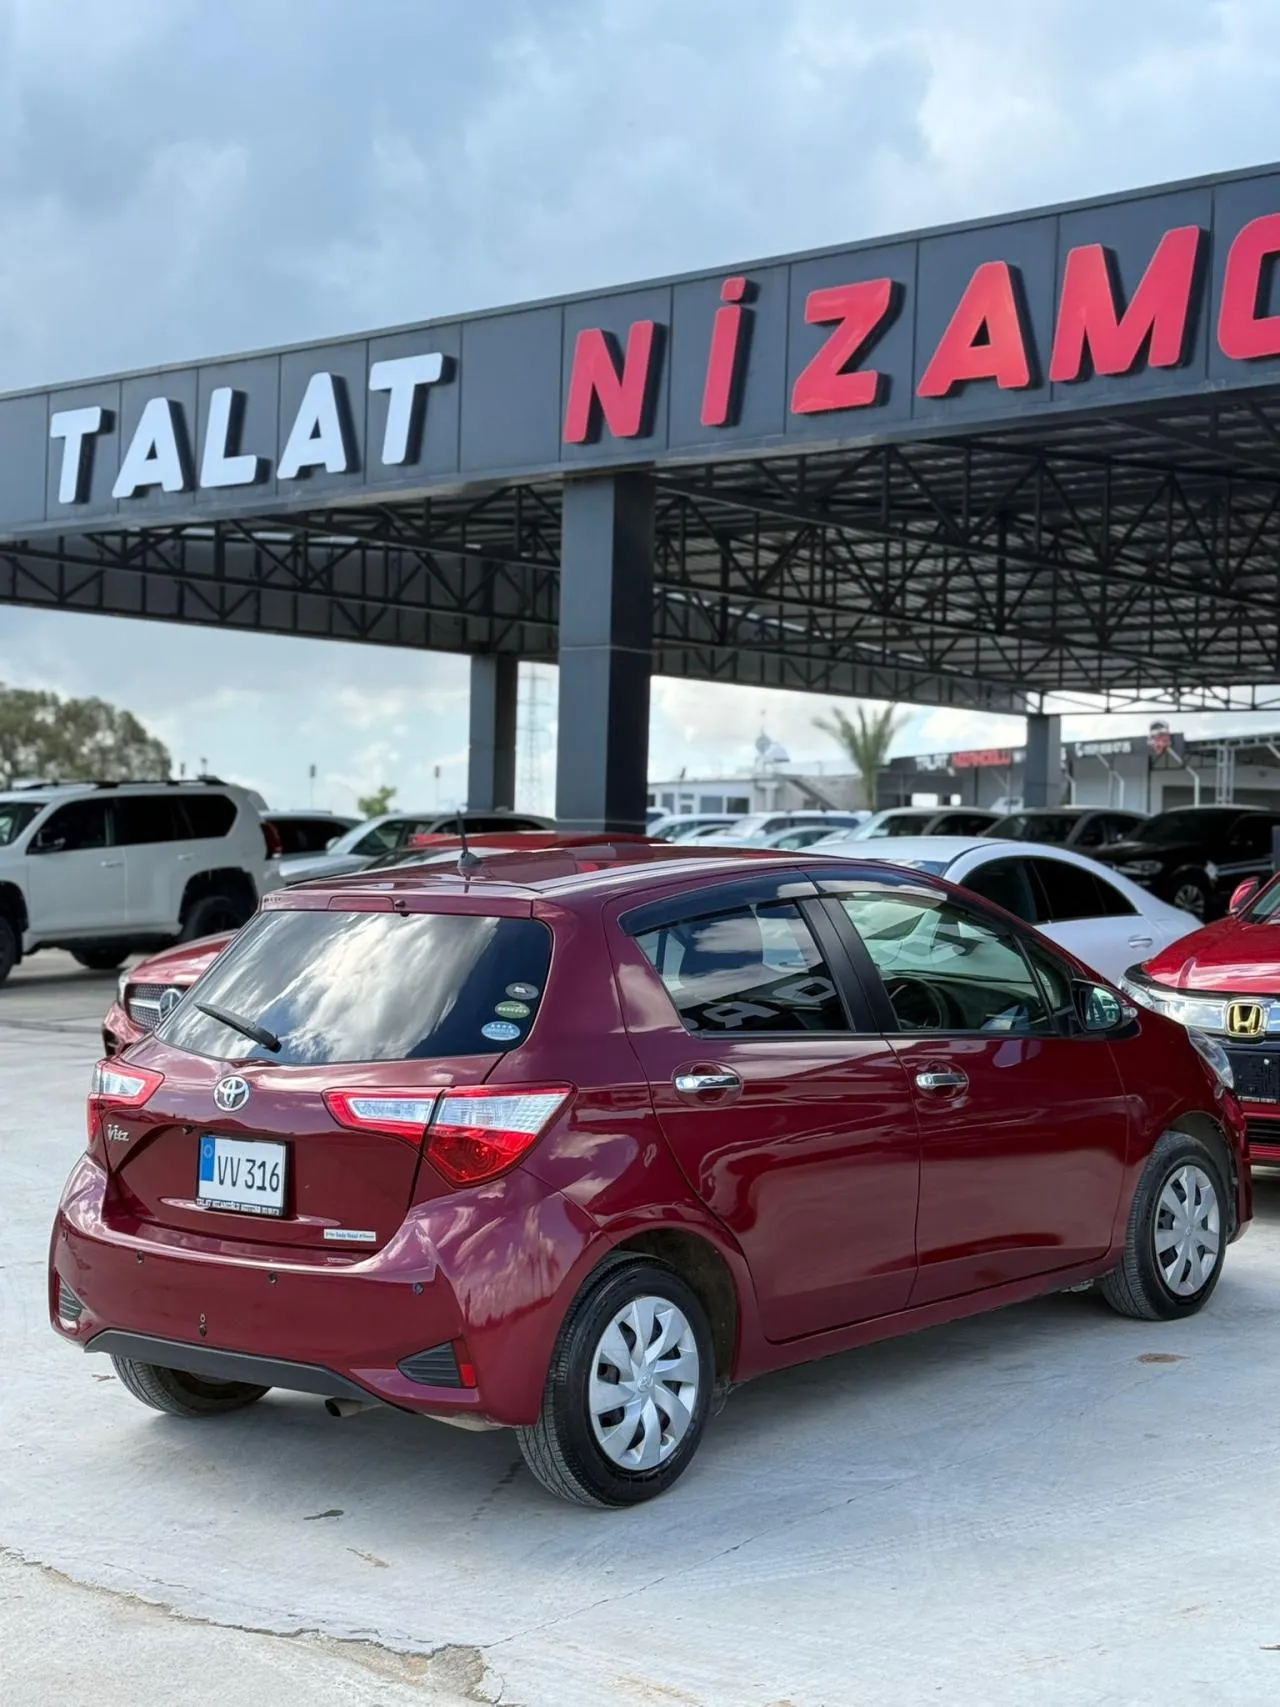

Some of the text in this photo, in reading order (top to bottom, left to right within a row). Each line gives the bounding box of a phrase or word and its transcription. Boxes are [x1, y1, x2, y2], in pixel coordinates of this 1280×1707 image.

[50, 351, 445, 504] TALAT
[107, 1123, 129, 1141] Vitz
[217, 1155, 280, 1193] VV 316
